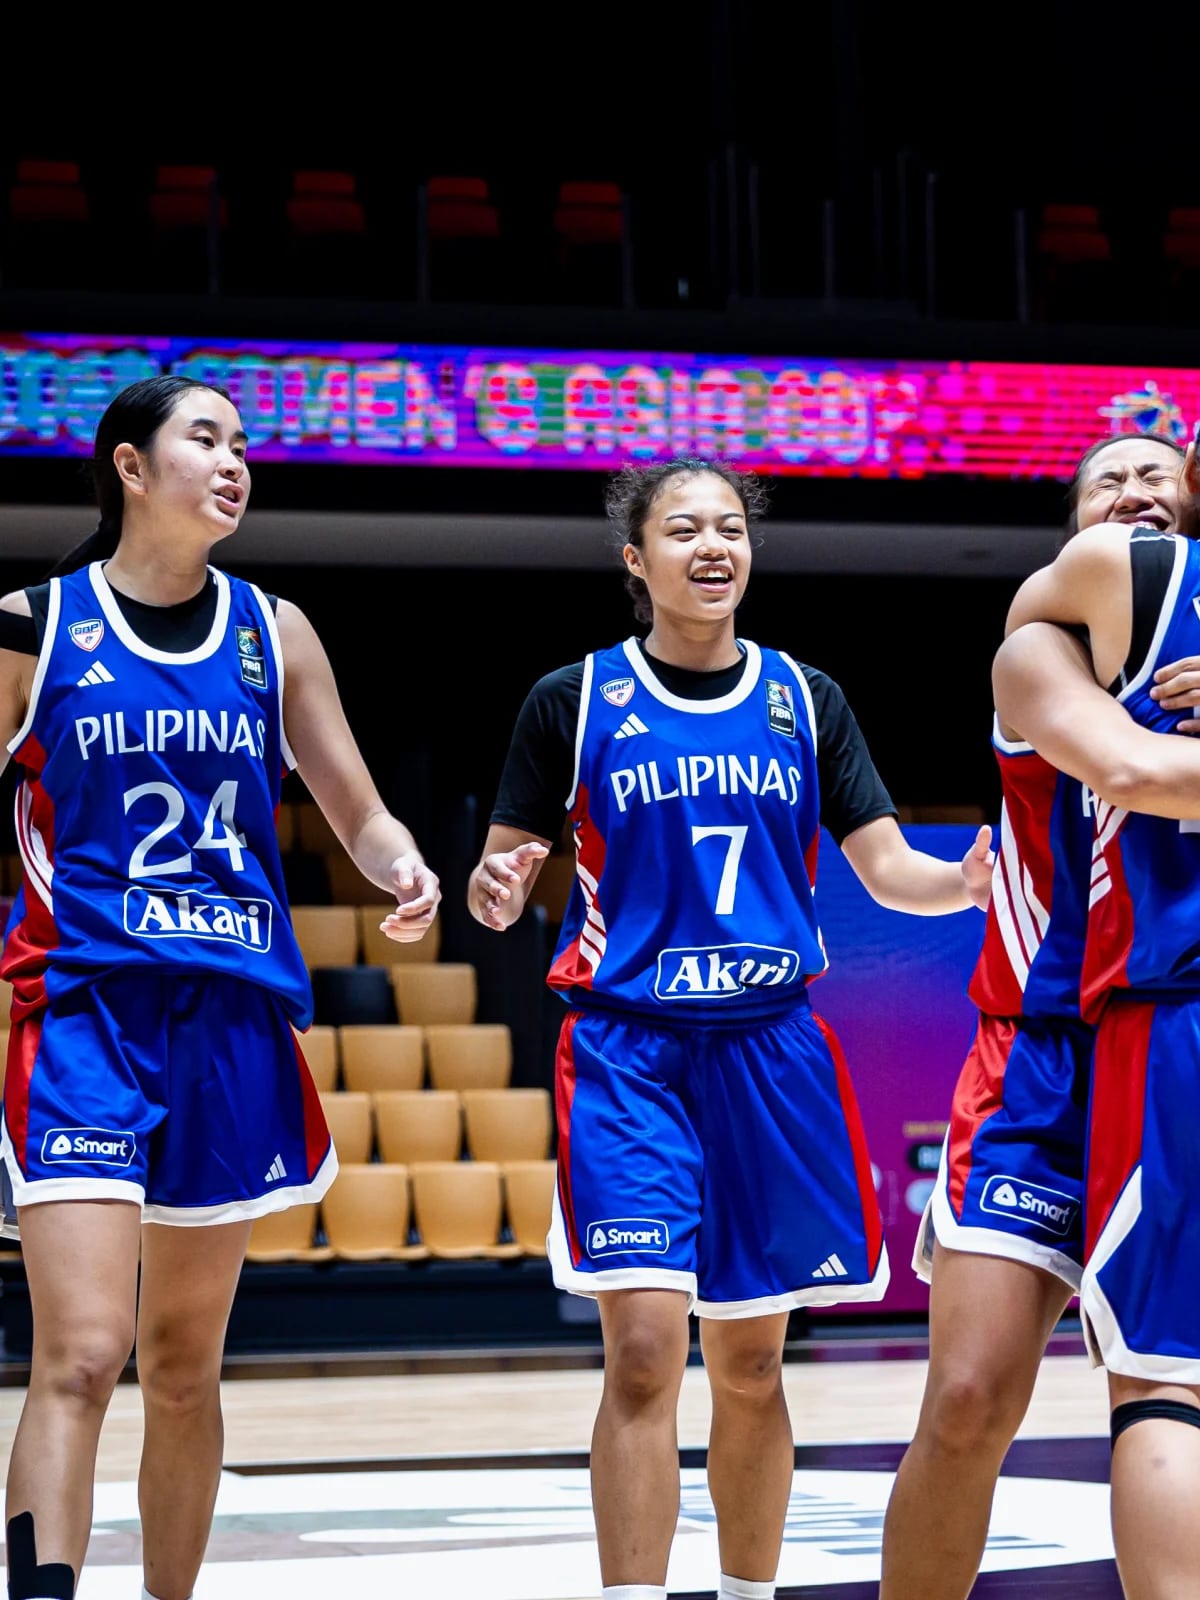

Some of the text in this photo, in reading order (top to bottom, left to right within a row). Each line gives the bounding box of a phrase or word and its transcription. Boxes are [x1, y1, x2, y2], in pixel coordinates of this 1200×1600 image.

[75, 709, 266, 761] PILIPINAS
[770, 706, 792, 720] FIBA
[610, 754, 802, 813] PILIPINAS
[123, 780, 248, 879] 24
[691, 825, 749, 915] 7
[135, 895, 262, 946] Akari
[73, 1136, 129, 1157] Smart
[1018, 1191, 1071, 1225] Smart
[608, 1228, 662, 1245] Smart
